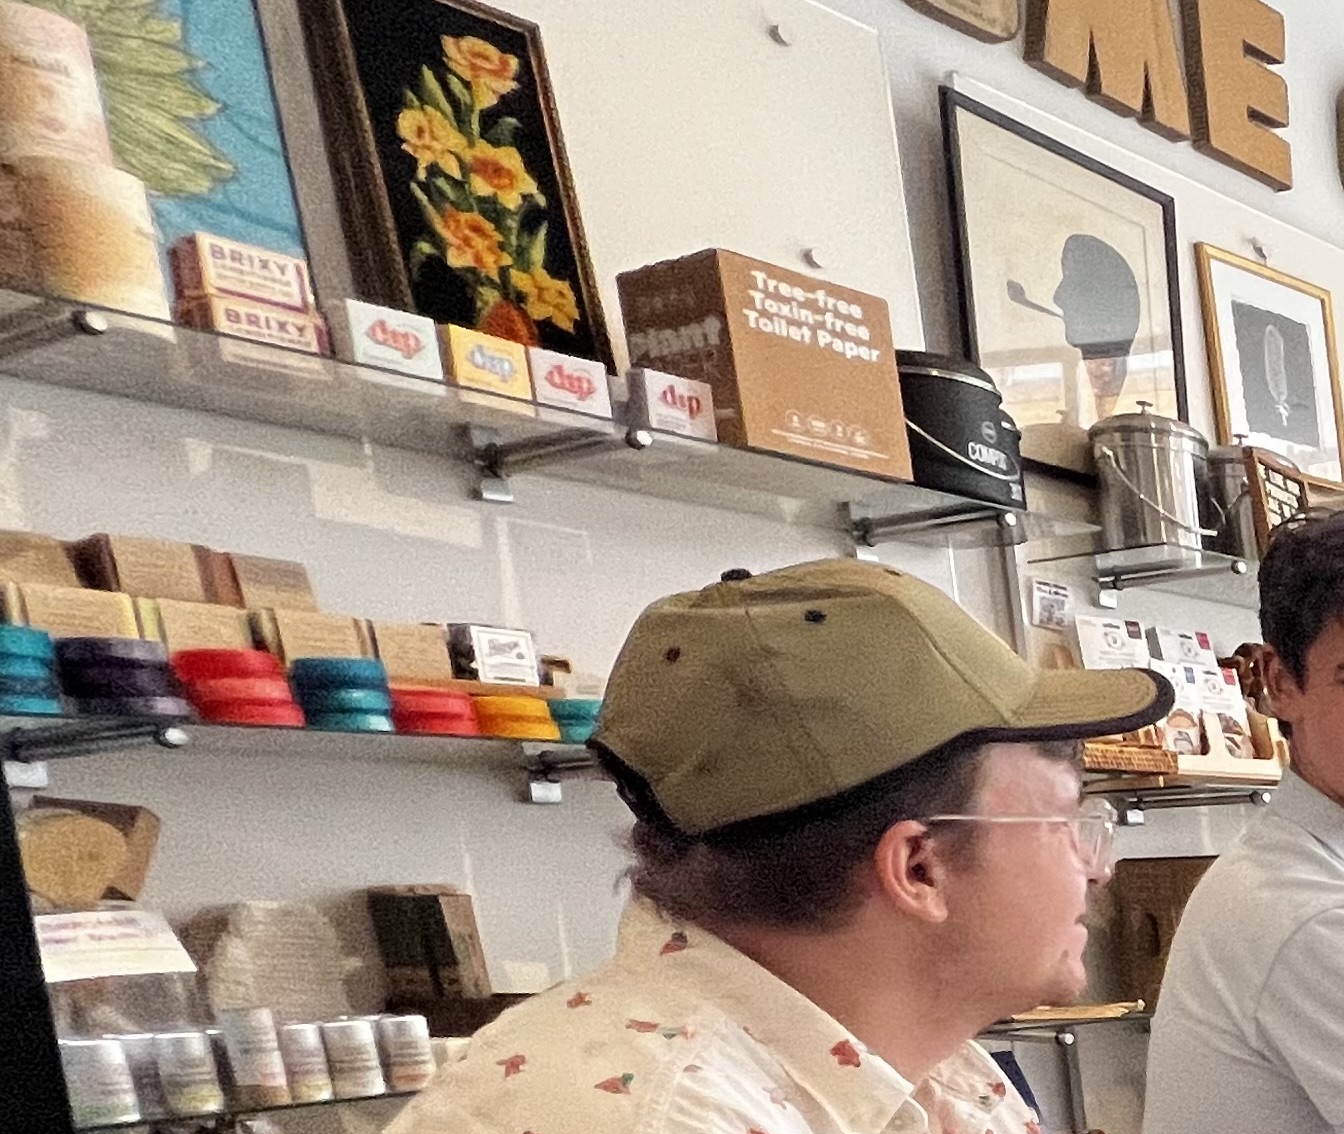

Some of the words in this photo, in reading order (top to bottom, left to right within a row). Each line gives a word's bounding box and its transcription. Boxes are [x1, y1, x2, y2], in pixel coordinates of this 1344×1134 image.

[208, 243, 290, 277] BRIXY
[748, 289, 871, 342] Toxin-free
[749, 269, 863, 321] Tree-free
[225, 307, 306, 335] BRIXY
[743, 308, 812, 343] Toilet
[815, 328, 881, 364] Paper
[659, 383, 703, 420] dip
